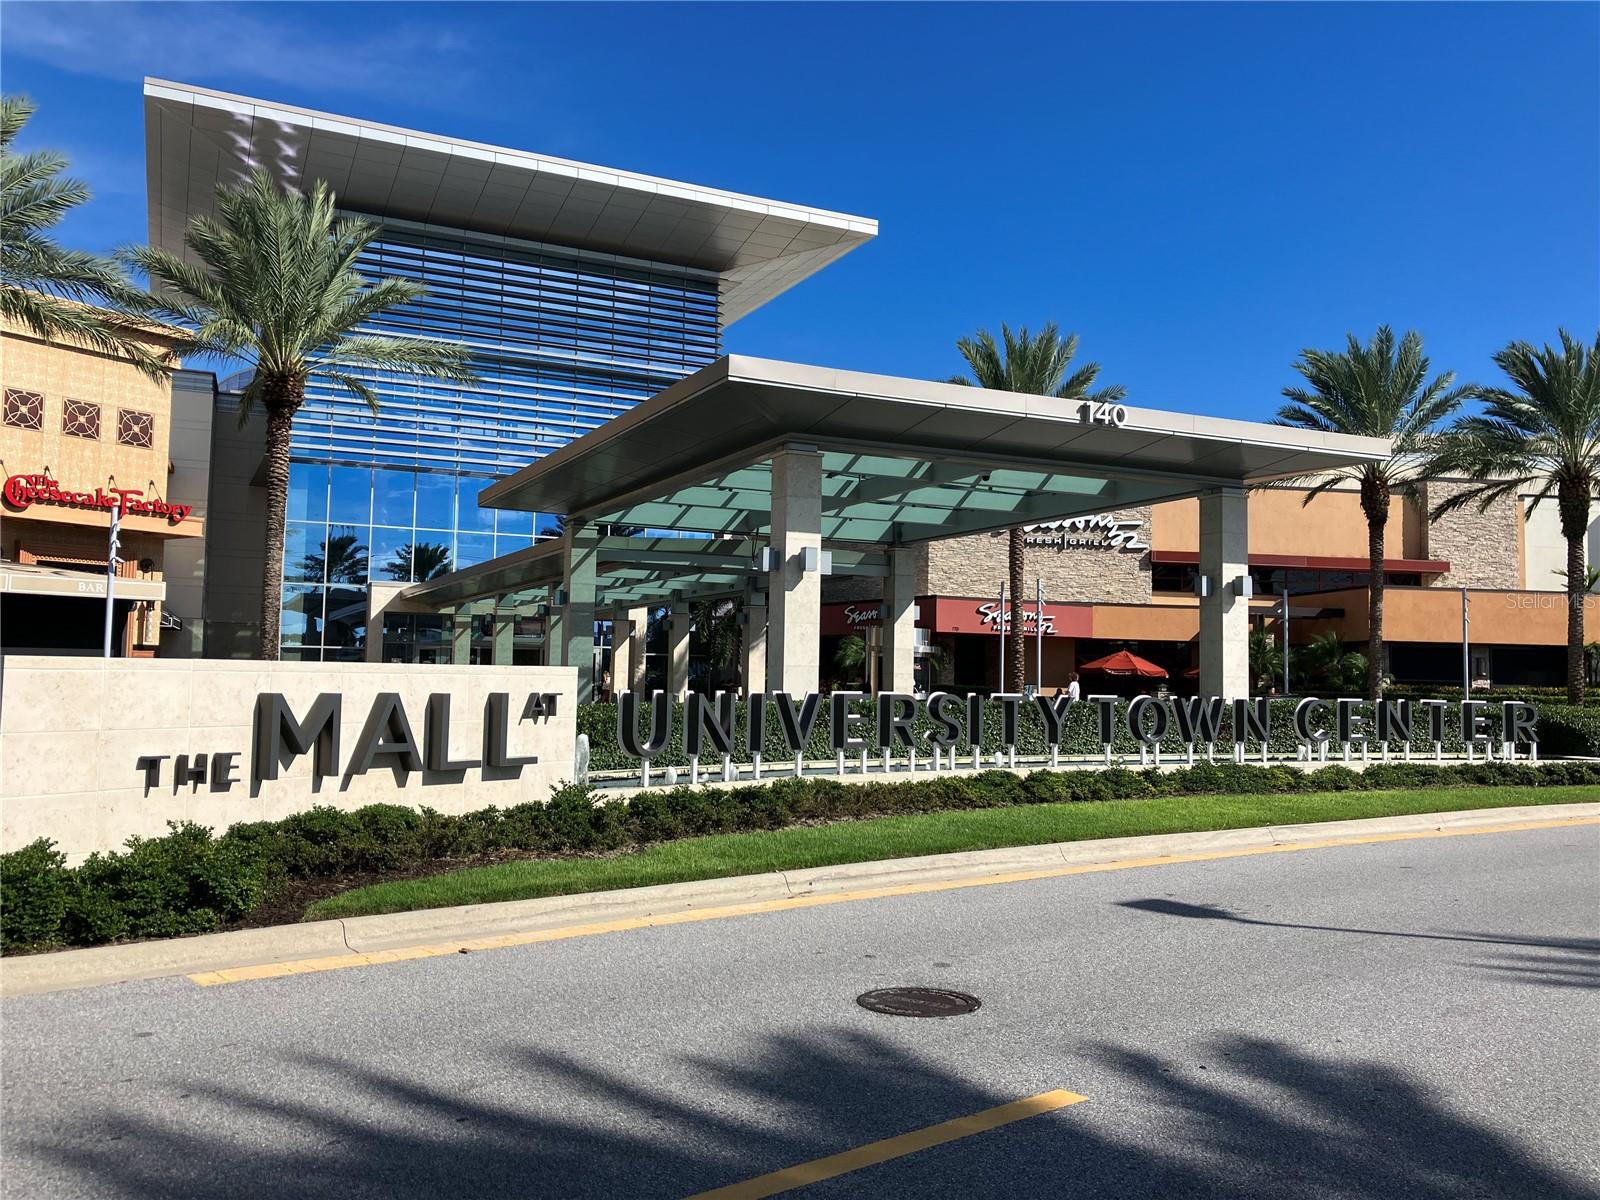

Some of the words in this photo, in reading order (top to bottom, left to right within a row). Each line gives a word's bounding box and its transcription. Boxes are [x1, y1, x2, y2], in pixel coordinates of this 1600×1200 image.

[1076, 401, 1128, 426] 140
[31, 474, 59, 488] The
[4, 474, 119, 508] Cheesecake
[110, 487, 192, 522] Factory
[1026, 537, 1062, 545] RESH
[1069, 538, 1107, 546] GRILL
[1108, 525, 1150, 549] 52
[78, 582, 104, 592] BAR
[618, 689, 1075, 757] UNIVERSITY
[1087, 695, 1271, 744] TOWN
[1293, 697, 1541, 743] CENTER
[136, 752, 241, 798] THE
[251, 692, 538, 796] MALL
[518, 692, 563, 725] AT
